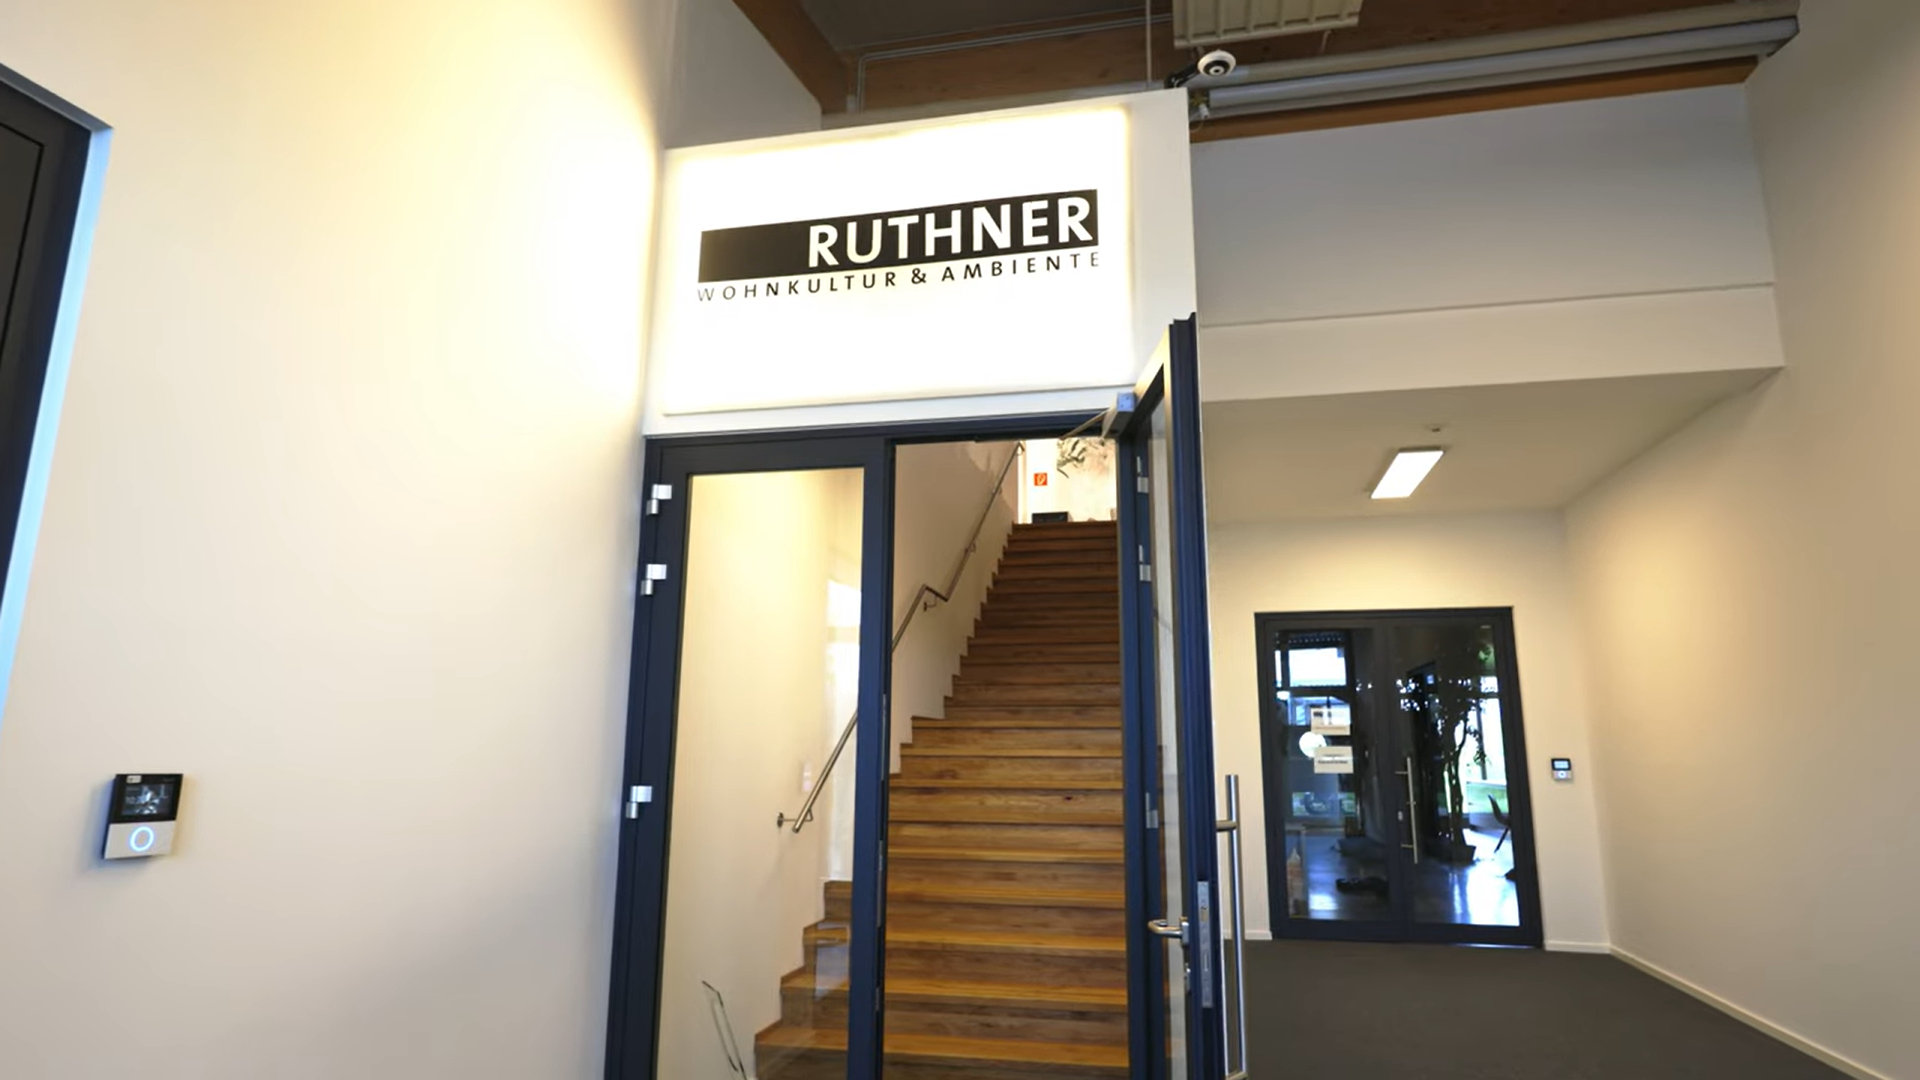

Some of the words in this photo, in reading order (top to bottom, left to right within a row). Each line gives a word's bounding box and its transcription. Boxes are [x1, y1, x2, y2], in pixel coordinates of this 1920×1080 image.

[807, 196, 1093, 269] RUTHNER
[697, 271, 896, 302] WOHNKULTUR
[911, 267, 927, 285] &
[941, 251, 1099, 282] AMBIENTE
